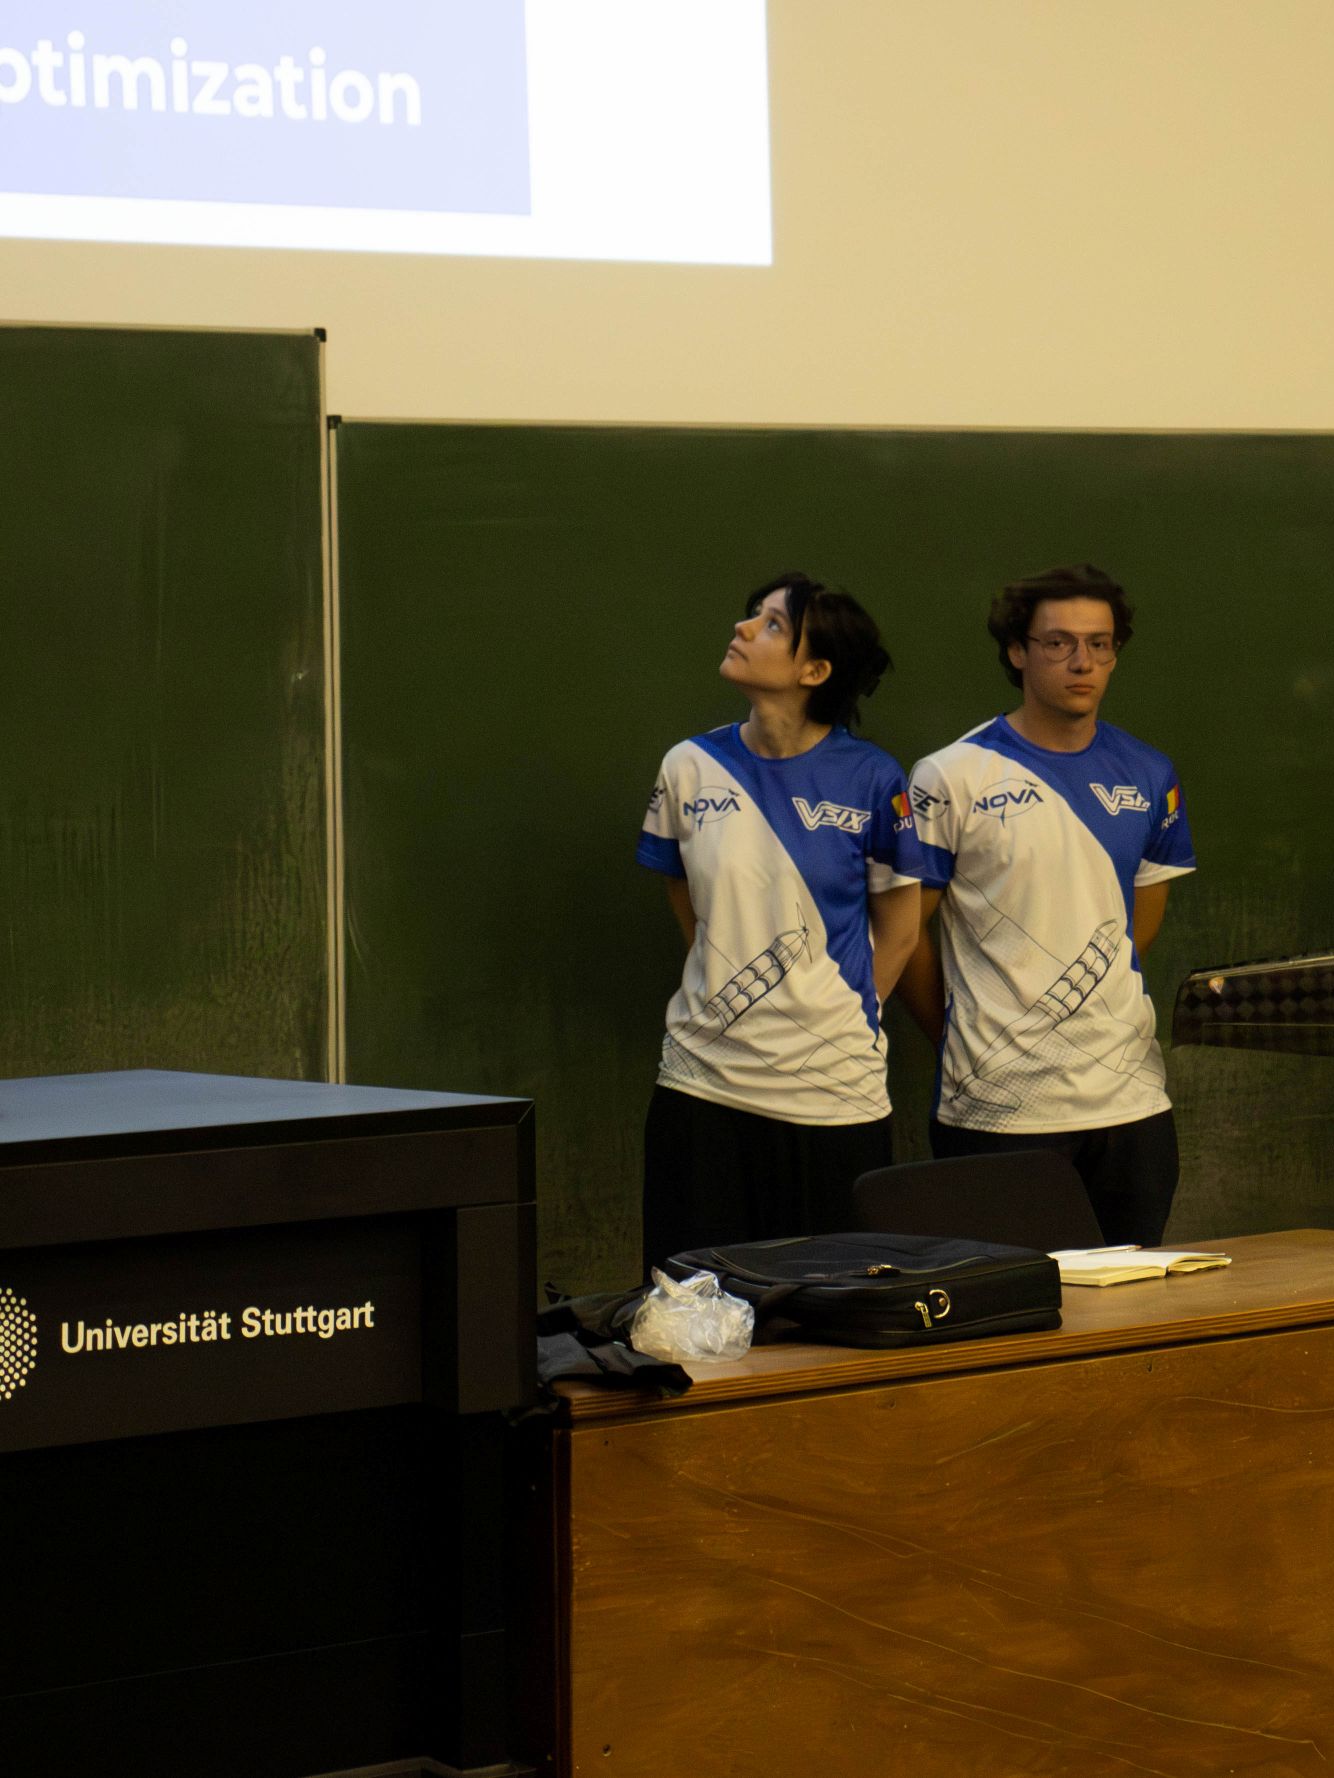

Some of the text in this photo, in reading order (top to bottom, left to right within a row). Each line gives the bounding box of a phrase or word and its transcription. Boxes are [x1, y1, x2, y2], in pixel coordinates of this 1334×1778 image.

[683, 797, 741, 817] NOVA
[972, 788, 1044, 813] NOVA
[61, 1301, 375, 1354] Universität Stuttgart
